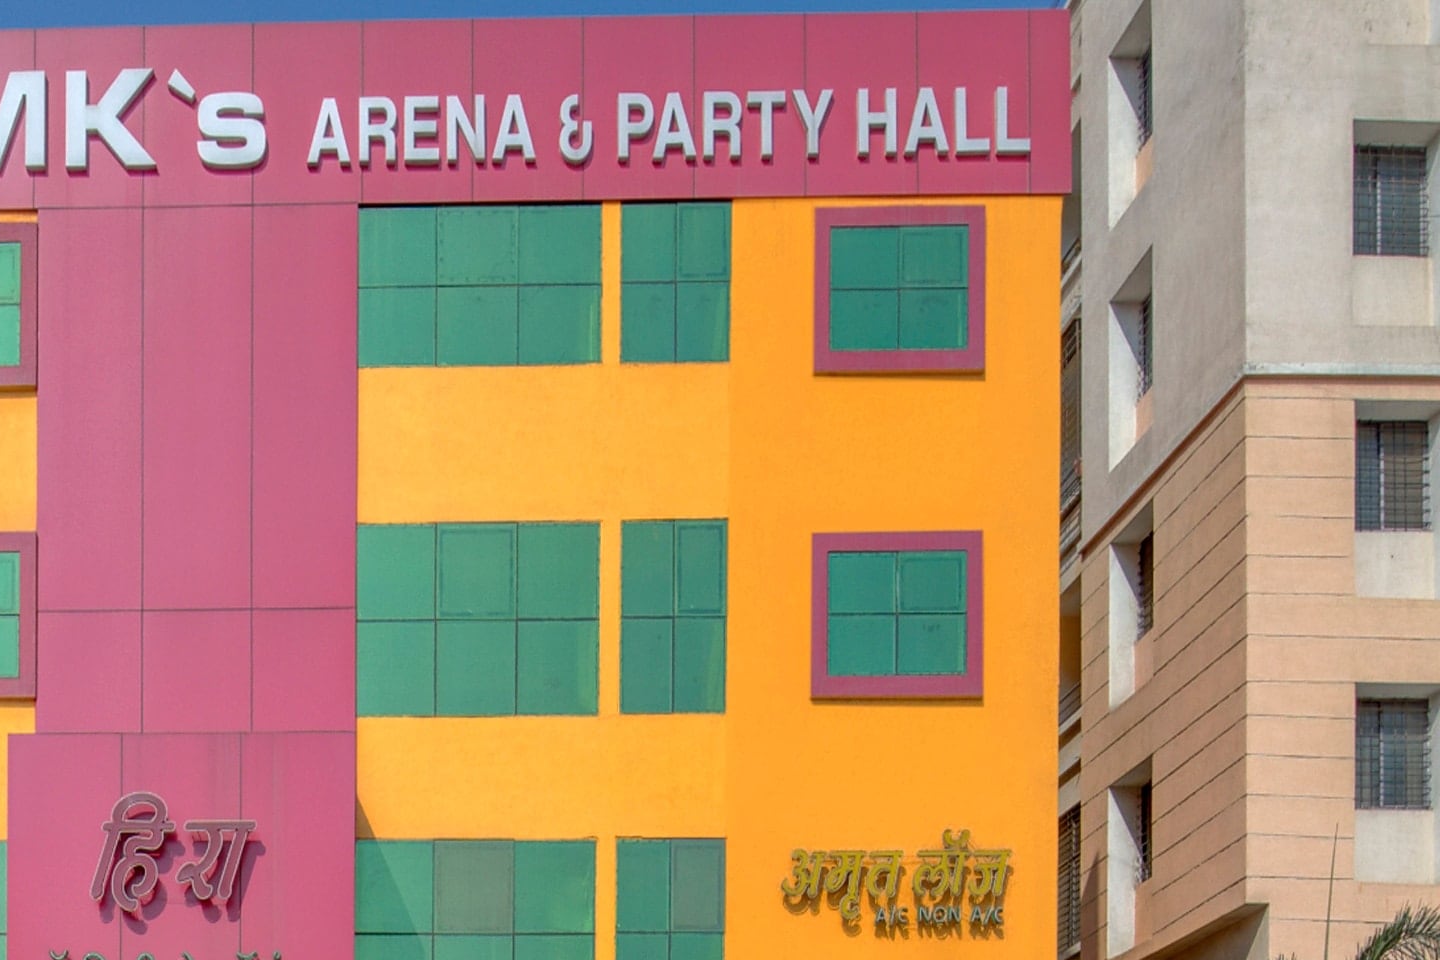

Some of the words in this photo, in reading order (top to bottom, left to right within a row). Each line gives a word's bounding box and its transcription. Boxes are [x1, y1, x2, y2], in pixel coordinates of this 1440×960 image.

[307, 94, 537, 168] ARENA
[559, 93, 593, 166] &
[616, 89, 834, 164] PARTY
[856, 86, 1032, 160] HALL
[90, 791, 257, 912] हिरा
[781, 848, 904, 920] अमृत
[912, 828, 1012, 897] लॉज
[874, 905, 909, 925] A/C
[918, 906, 961, 924] NON
[970, 905, 1004, 925] A/C
